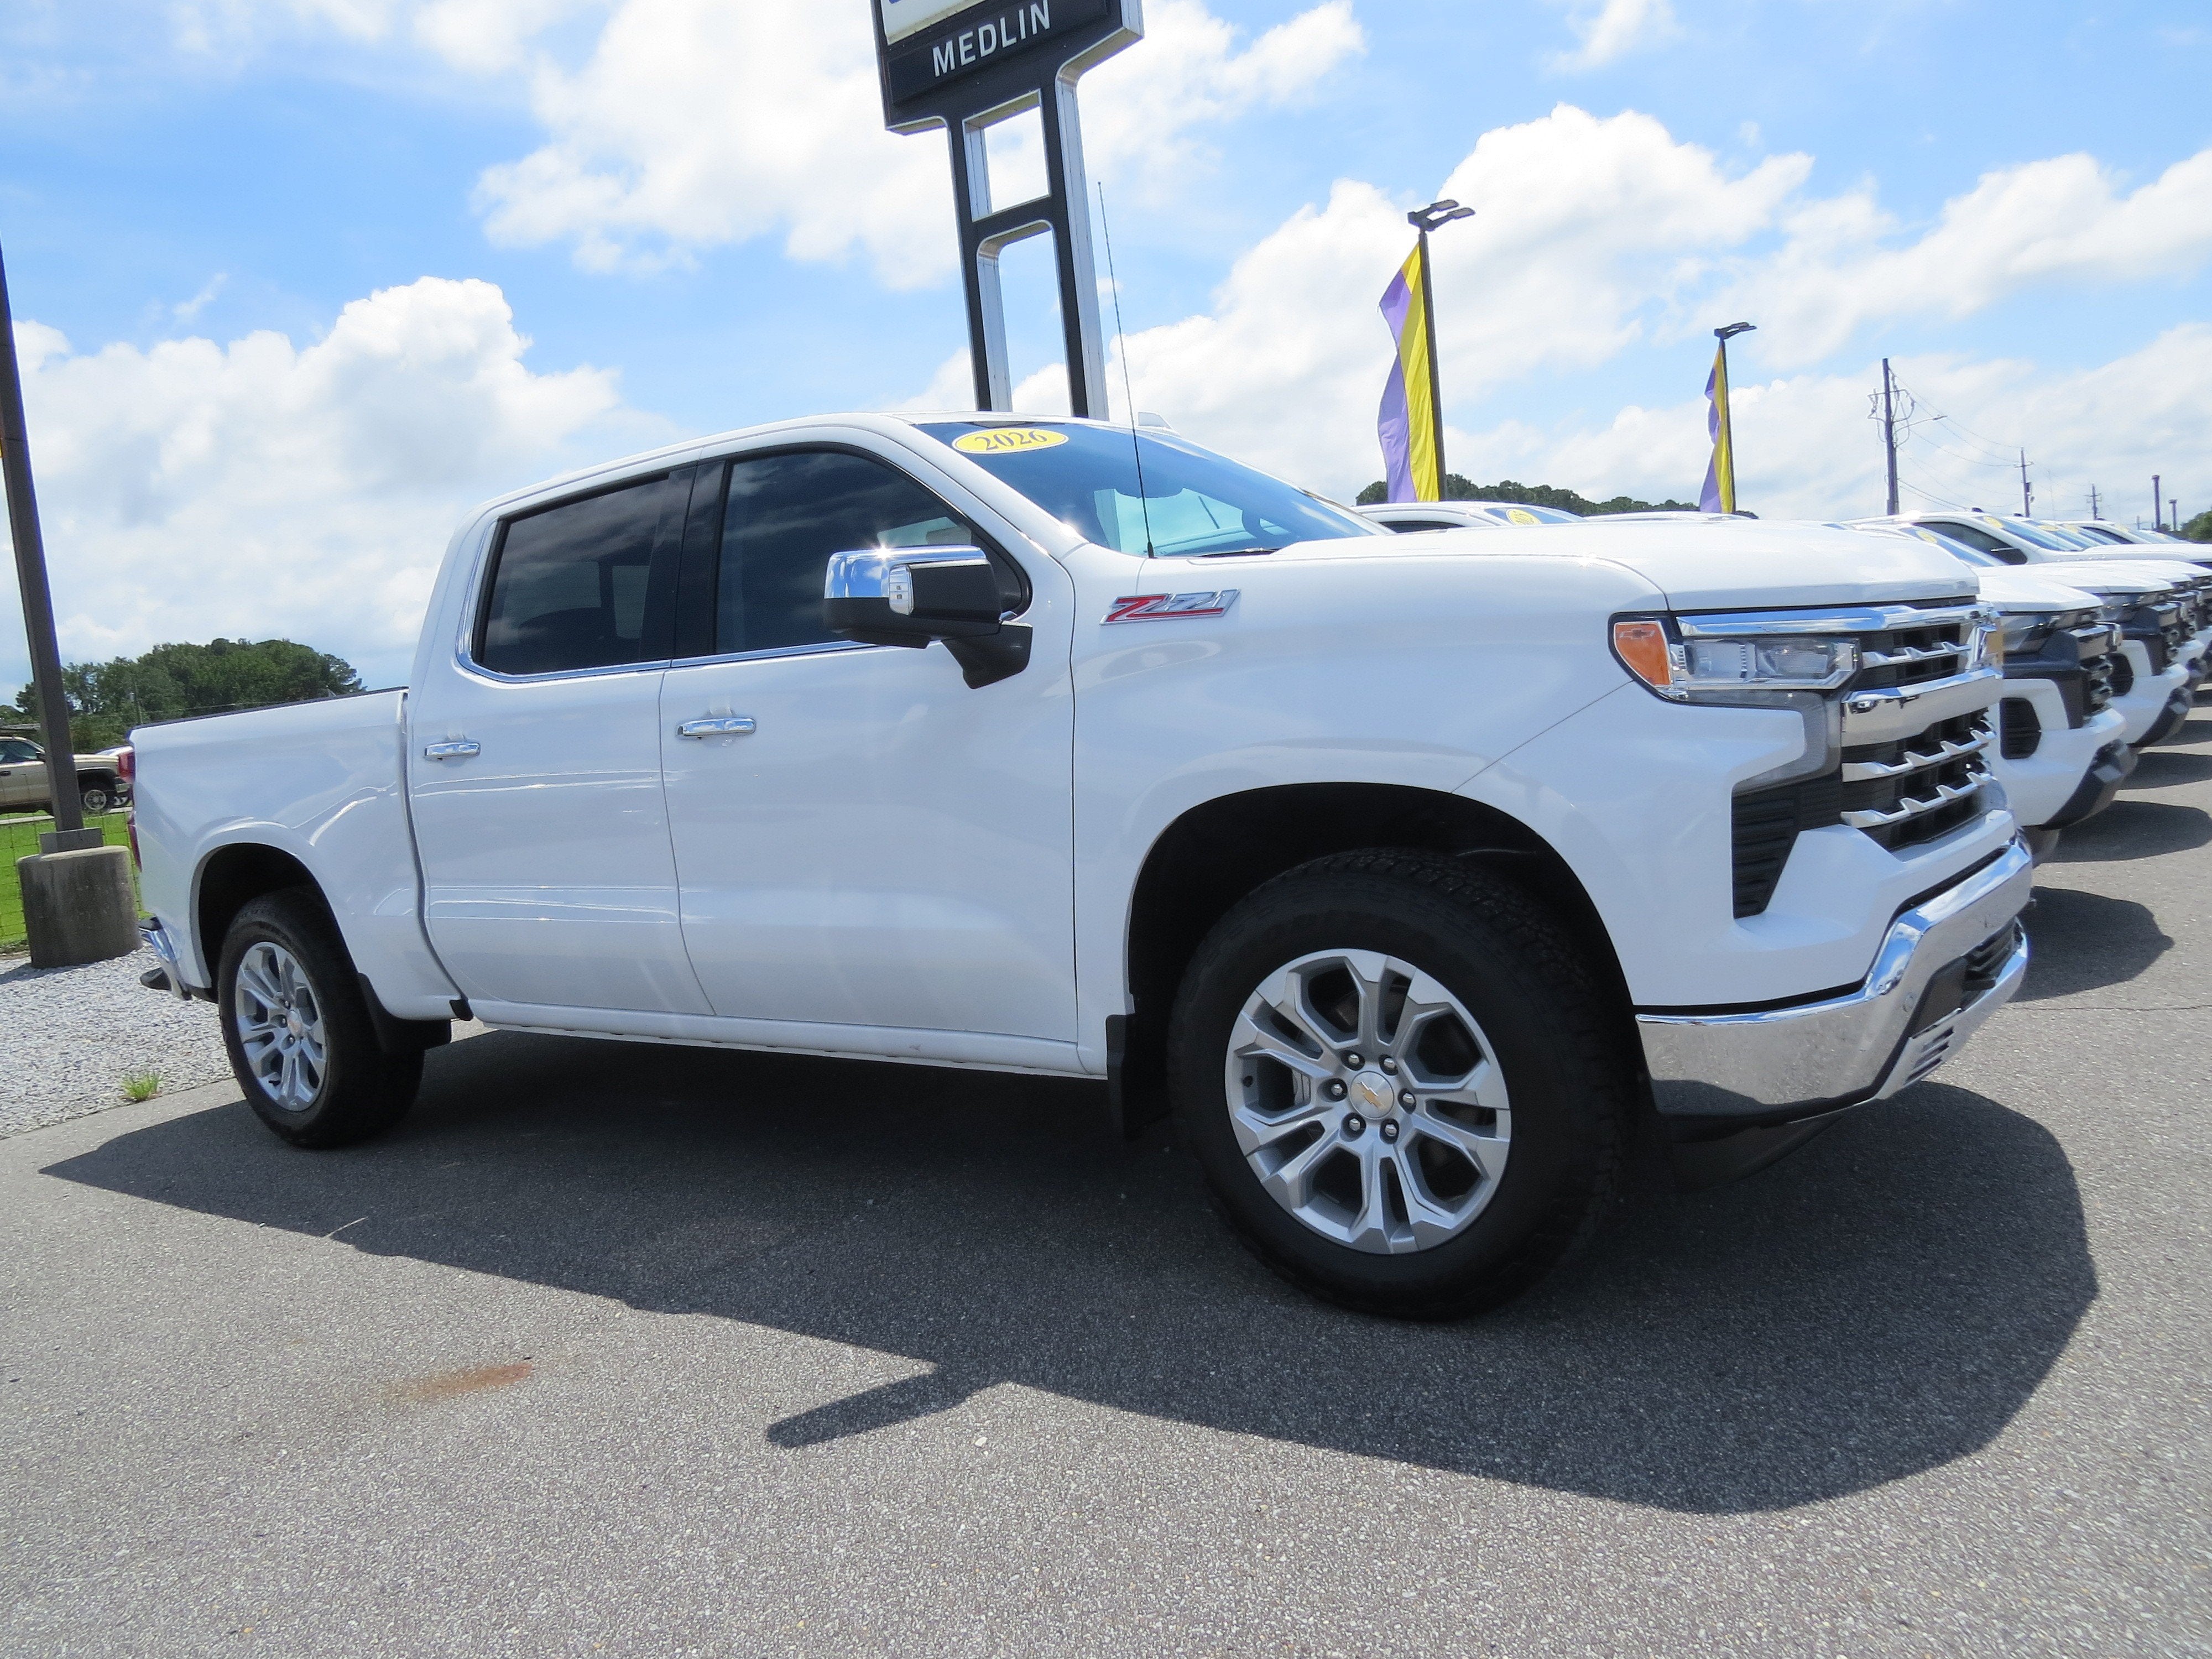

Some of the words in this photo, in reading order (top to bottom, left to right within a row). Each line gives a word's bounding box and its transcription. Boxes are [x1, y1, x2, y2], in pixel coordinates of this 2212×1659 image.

[932, 0, 1050, 77] MEDLIN
[974, 431, 1047, 451] 2026
[1099, 589, 1240, 625] Z71
